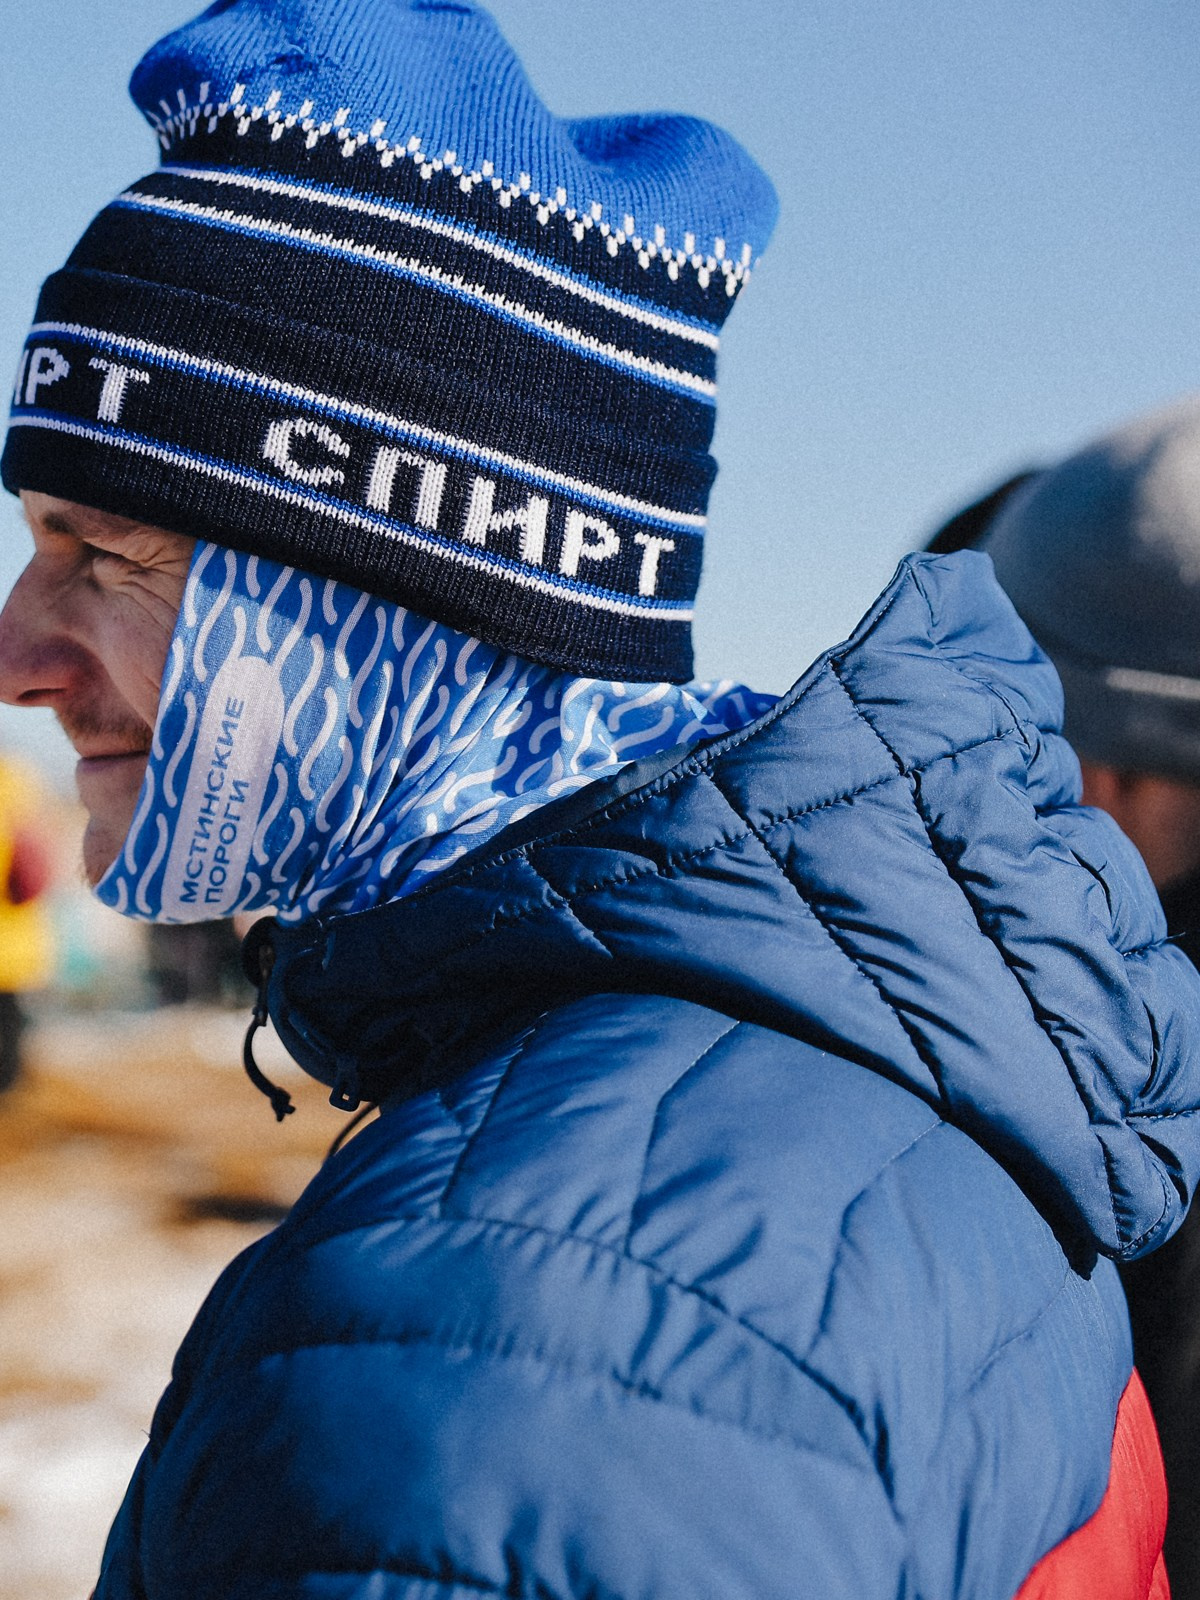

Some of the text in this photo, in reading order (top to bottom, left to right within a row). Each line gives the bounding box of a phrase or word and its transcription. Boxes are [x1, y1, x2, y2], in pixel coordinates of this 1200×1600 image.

[262, 417, 675, 596] СПИРТ
[179, 696, 245, 904] МСТИНСКИЕ
[204, 779, 250, 904] ПОРОГИ
